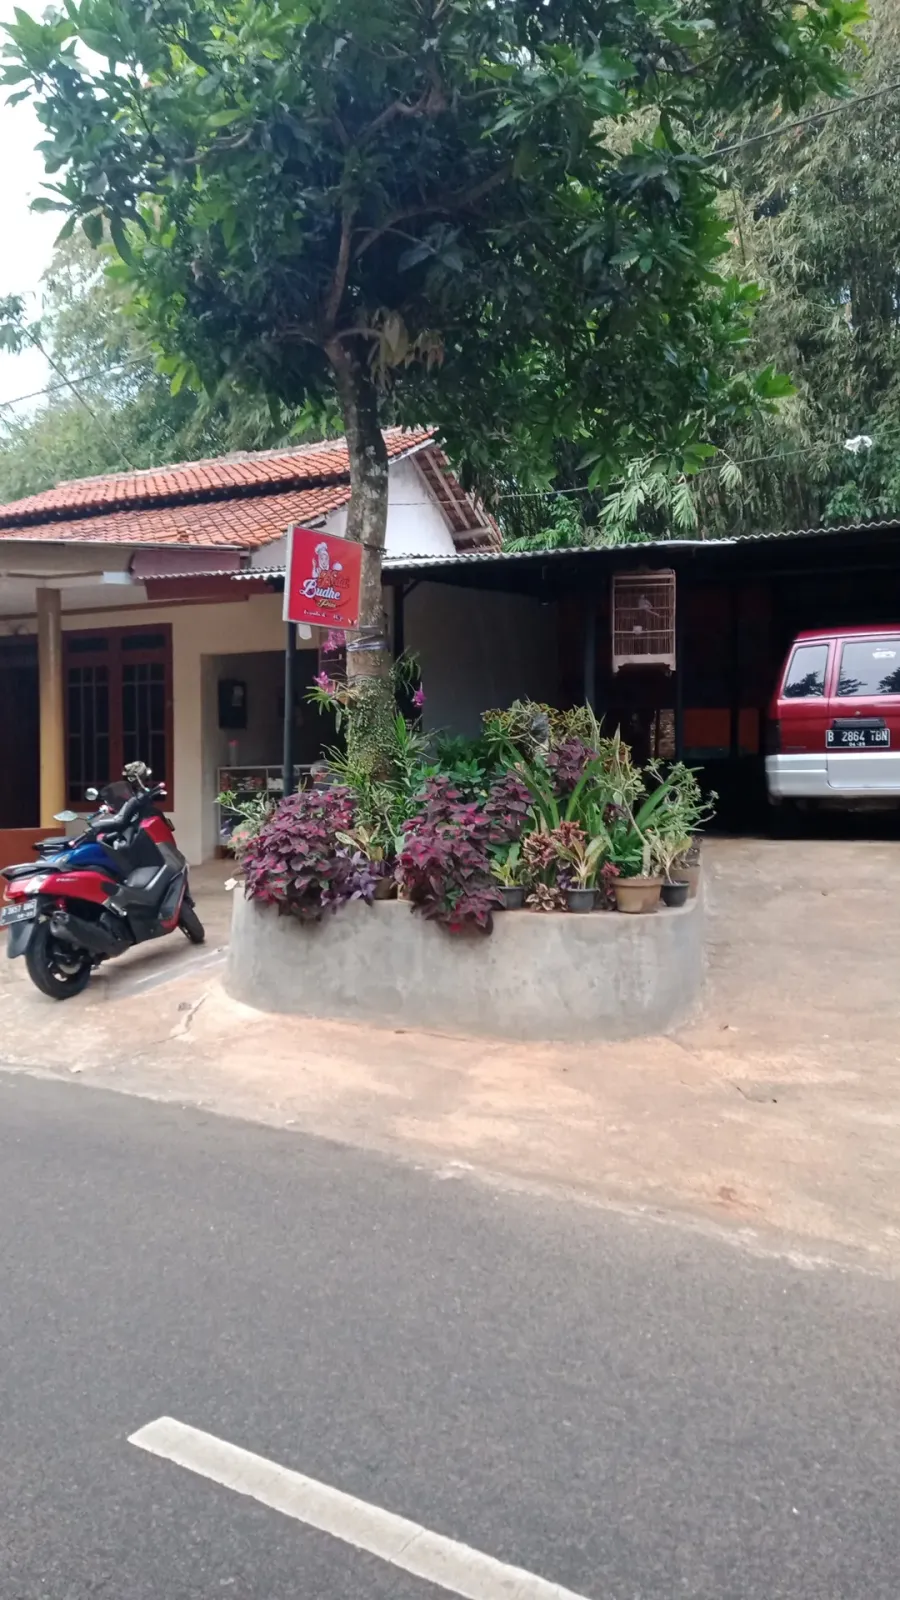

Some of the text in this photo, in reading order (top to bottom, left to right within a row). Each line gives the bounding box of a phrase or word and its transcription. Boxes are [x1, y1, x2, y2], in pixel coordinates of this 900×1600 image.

[299, 579, 341, 600] Budhe
[827, 730, 888, 742] B 2864 TBN
